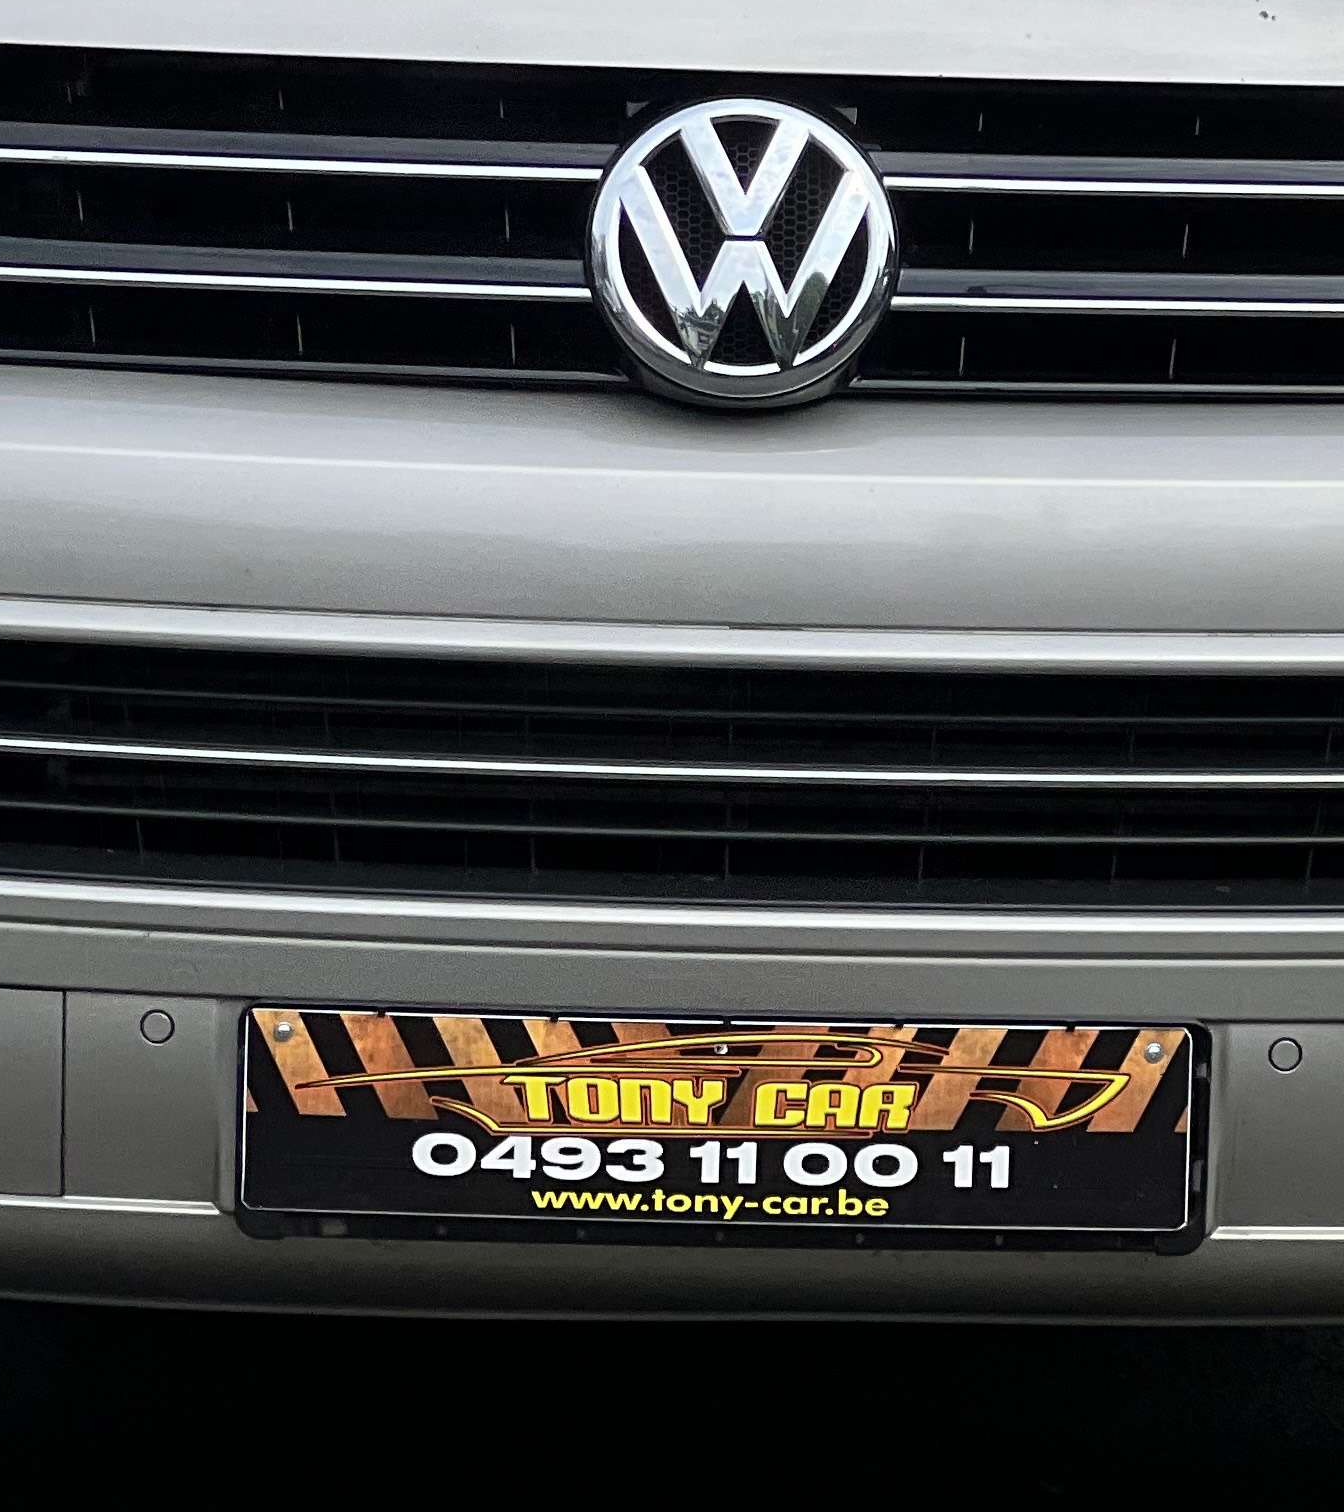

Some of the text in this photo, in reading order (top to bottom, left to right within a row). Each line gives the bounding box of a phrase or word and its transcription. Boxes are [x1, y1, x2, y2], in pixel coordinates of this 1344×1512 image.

[503, 1074, 918, 1130] TONY CAR
[411, 1131, 1011, 1189] 0493 11 00 11
[531, 1188, 890, 1221] www.tony-car.be
